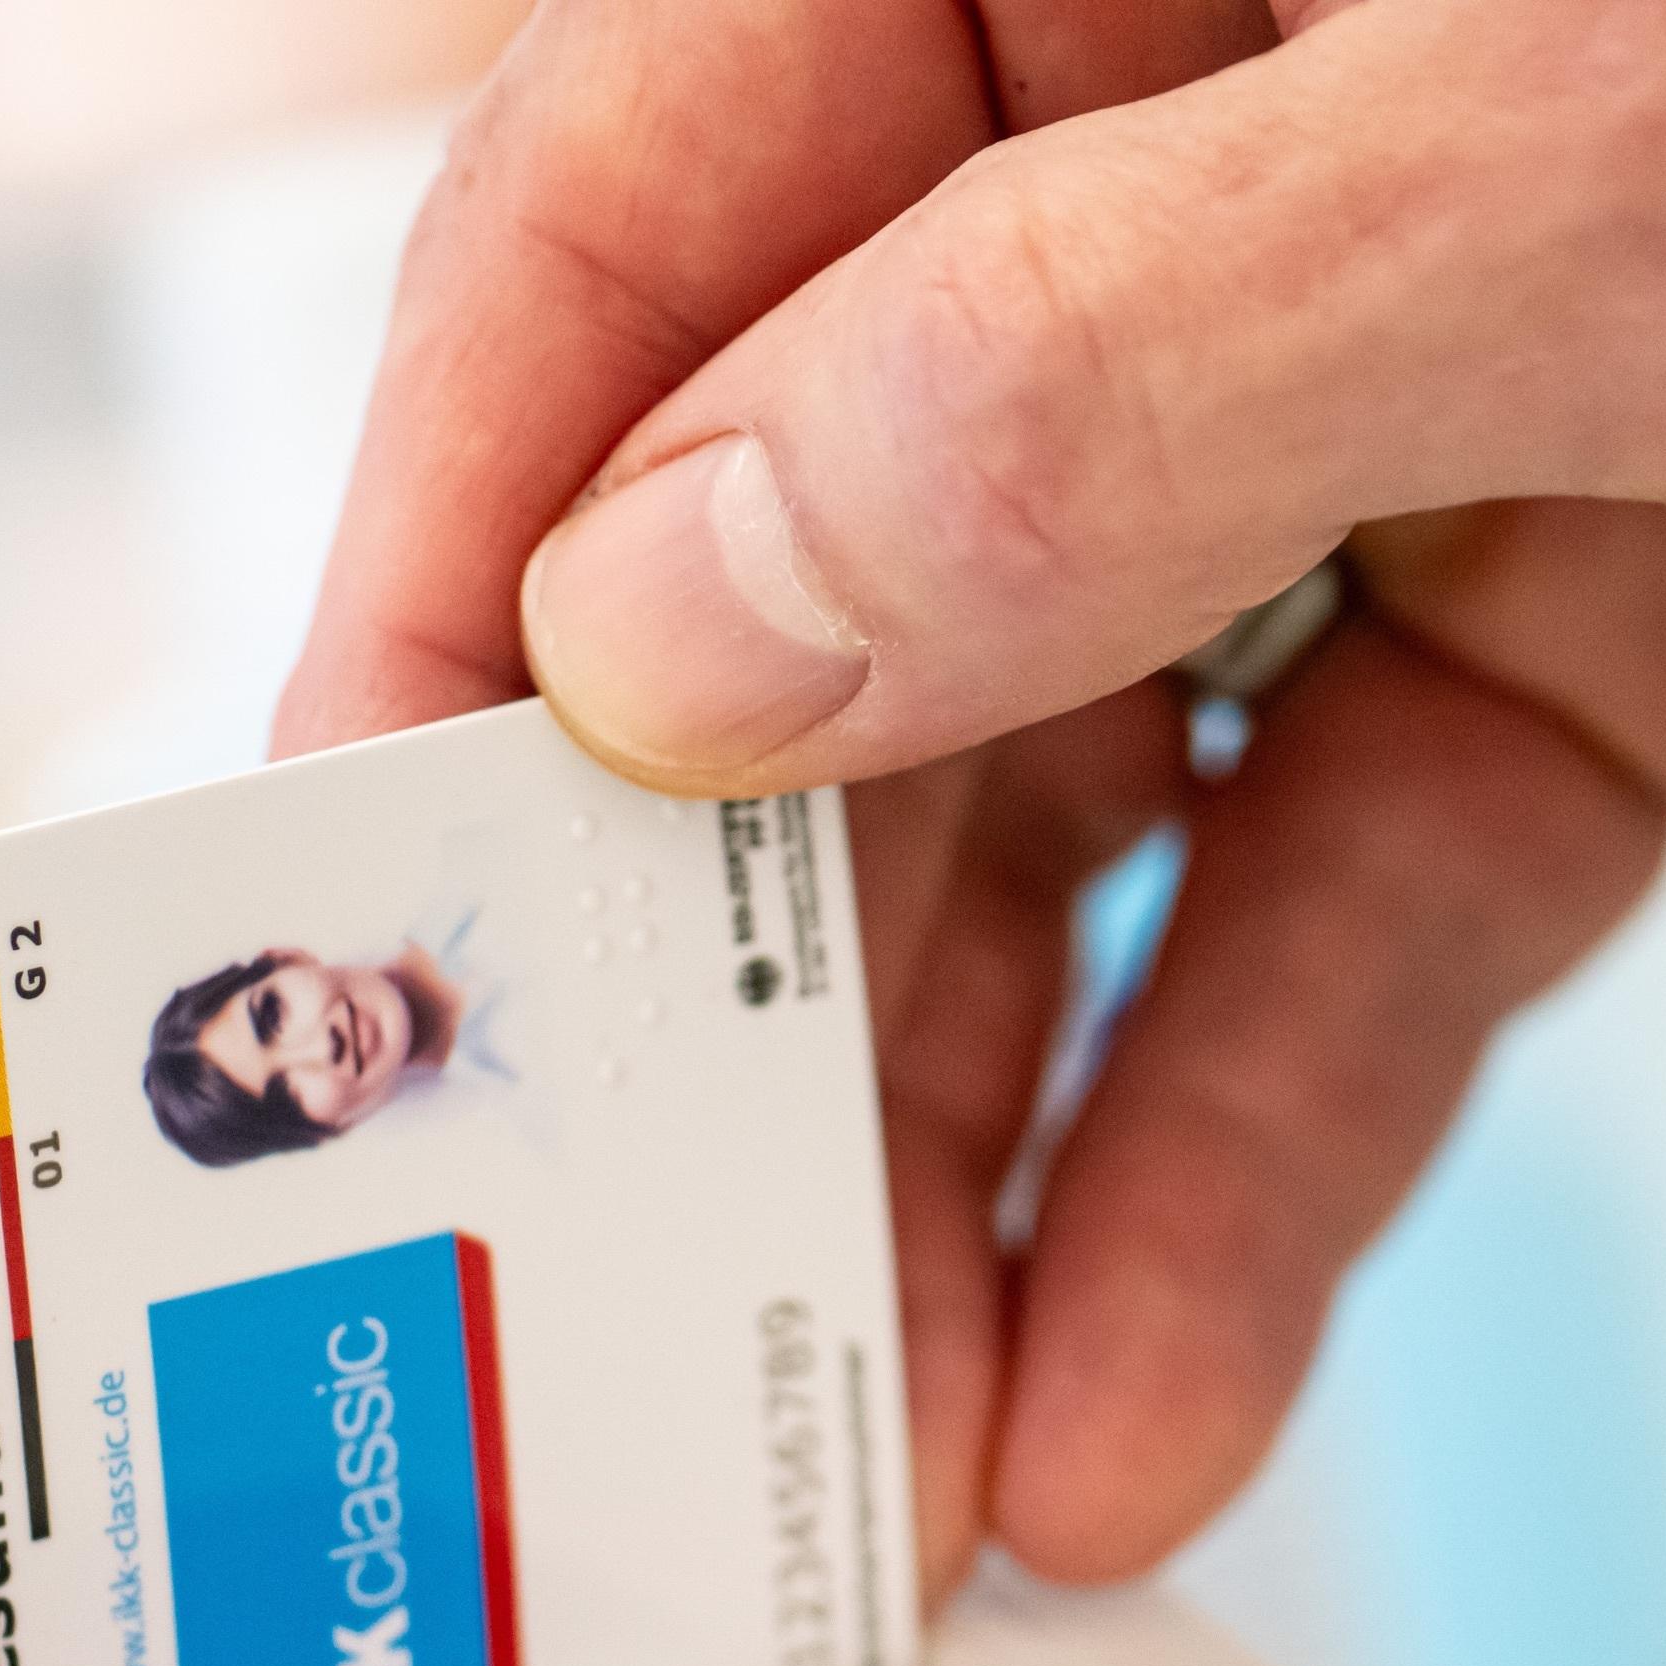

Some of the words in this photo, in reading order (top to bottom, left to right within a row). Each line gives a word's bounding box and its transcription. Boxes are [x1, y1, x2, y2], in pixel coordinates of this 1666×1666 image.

[10, 919, 42, 951] 2
[14, 966, 46, 1000] G
[314, 1315, 409, 1608] classic
